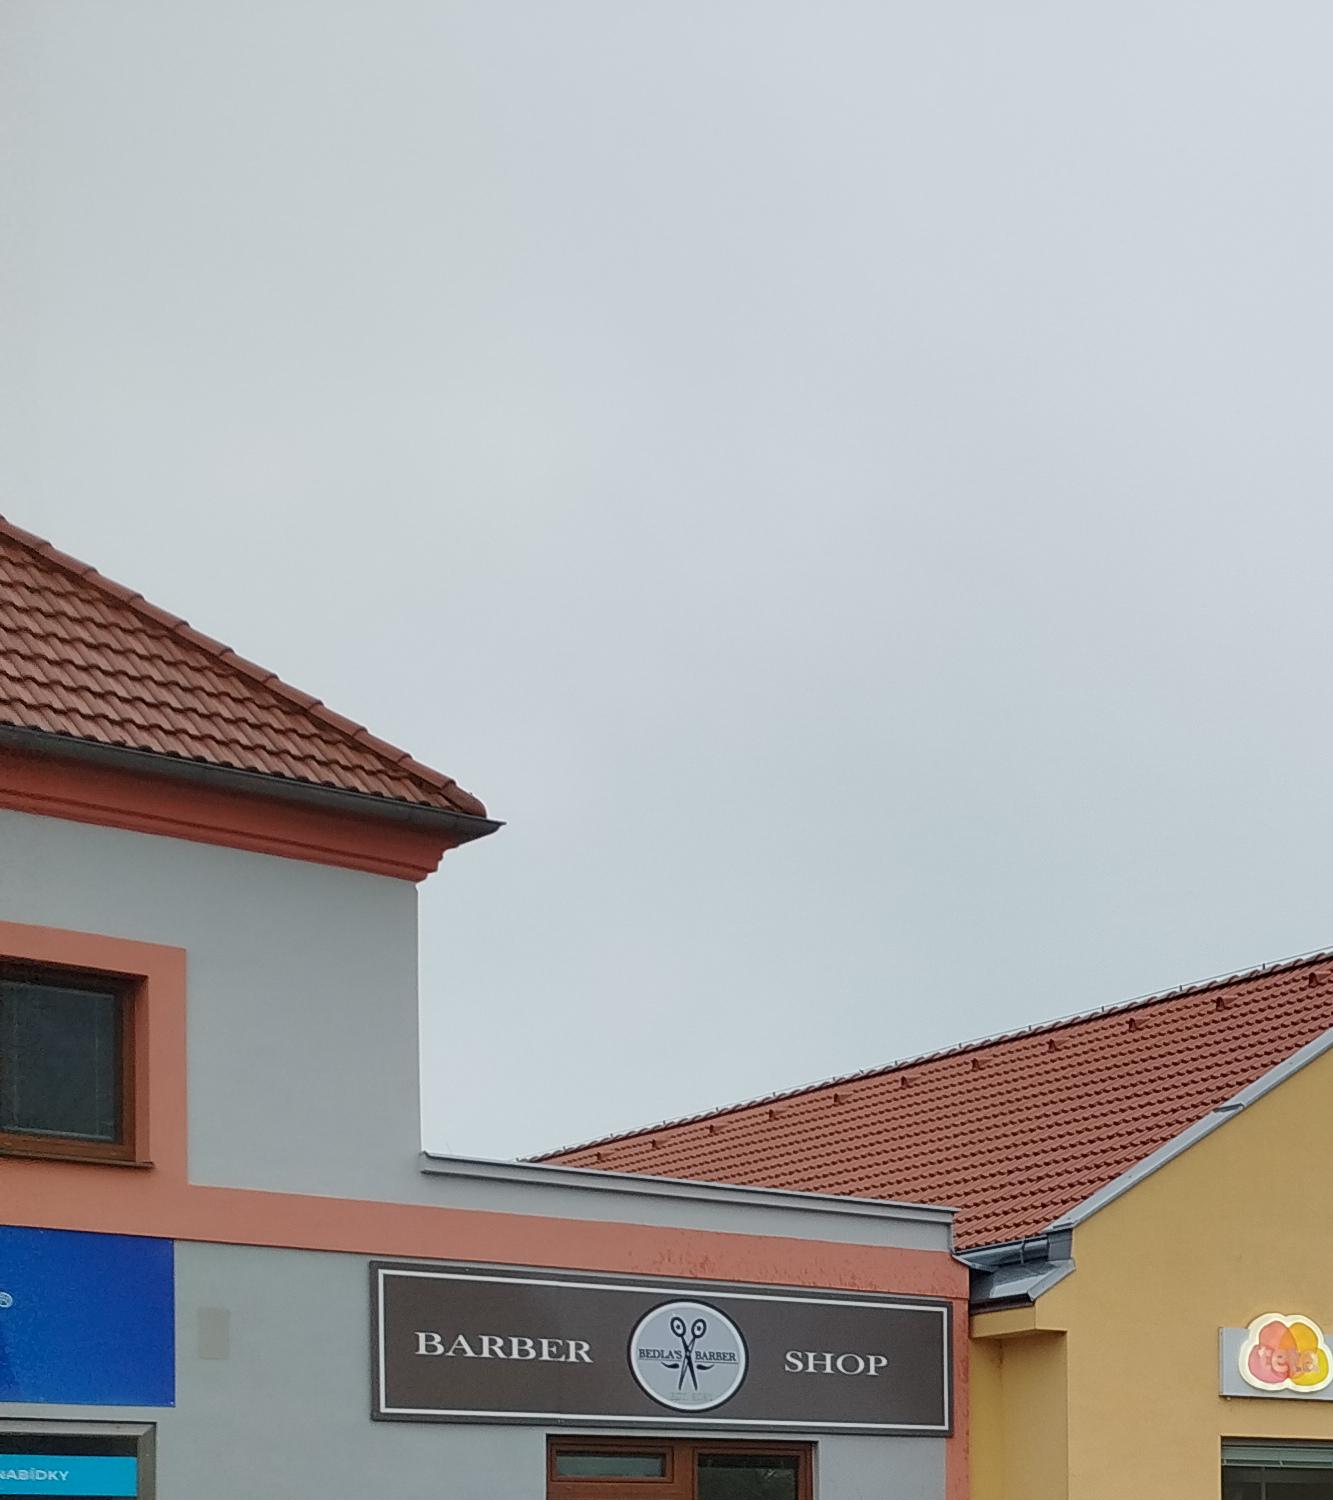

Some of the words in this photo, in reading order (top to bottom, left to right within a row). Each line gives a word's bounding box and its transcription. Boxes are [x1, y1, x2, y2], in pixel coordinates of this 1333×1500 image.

[414, 1331, 594, 1363] BARBER
[639, 1348, 682, 1360] BEDLA'S
[695, 1350, 737, 1362] BARBER
[1257, 1345, 1319, 1373] teta
[784, 1350, 888, 1376] SHOP
